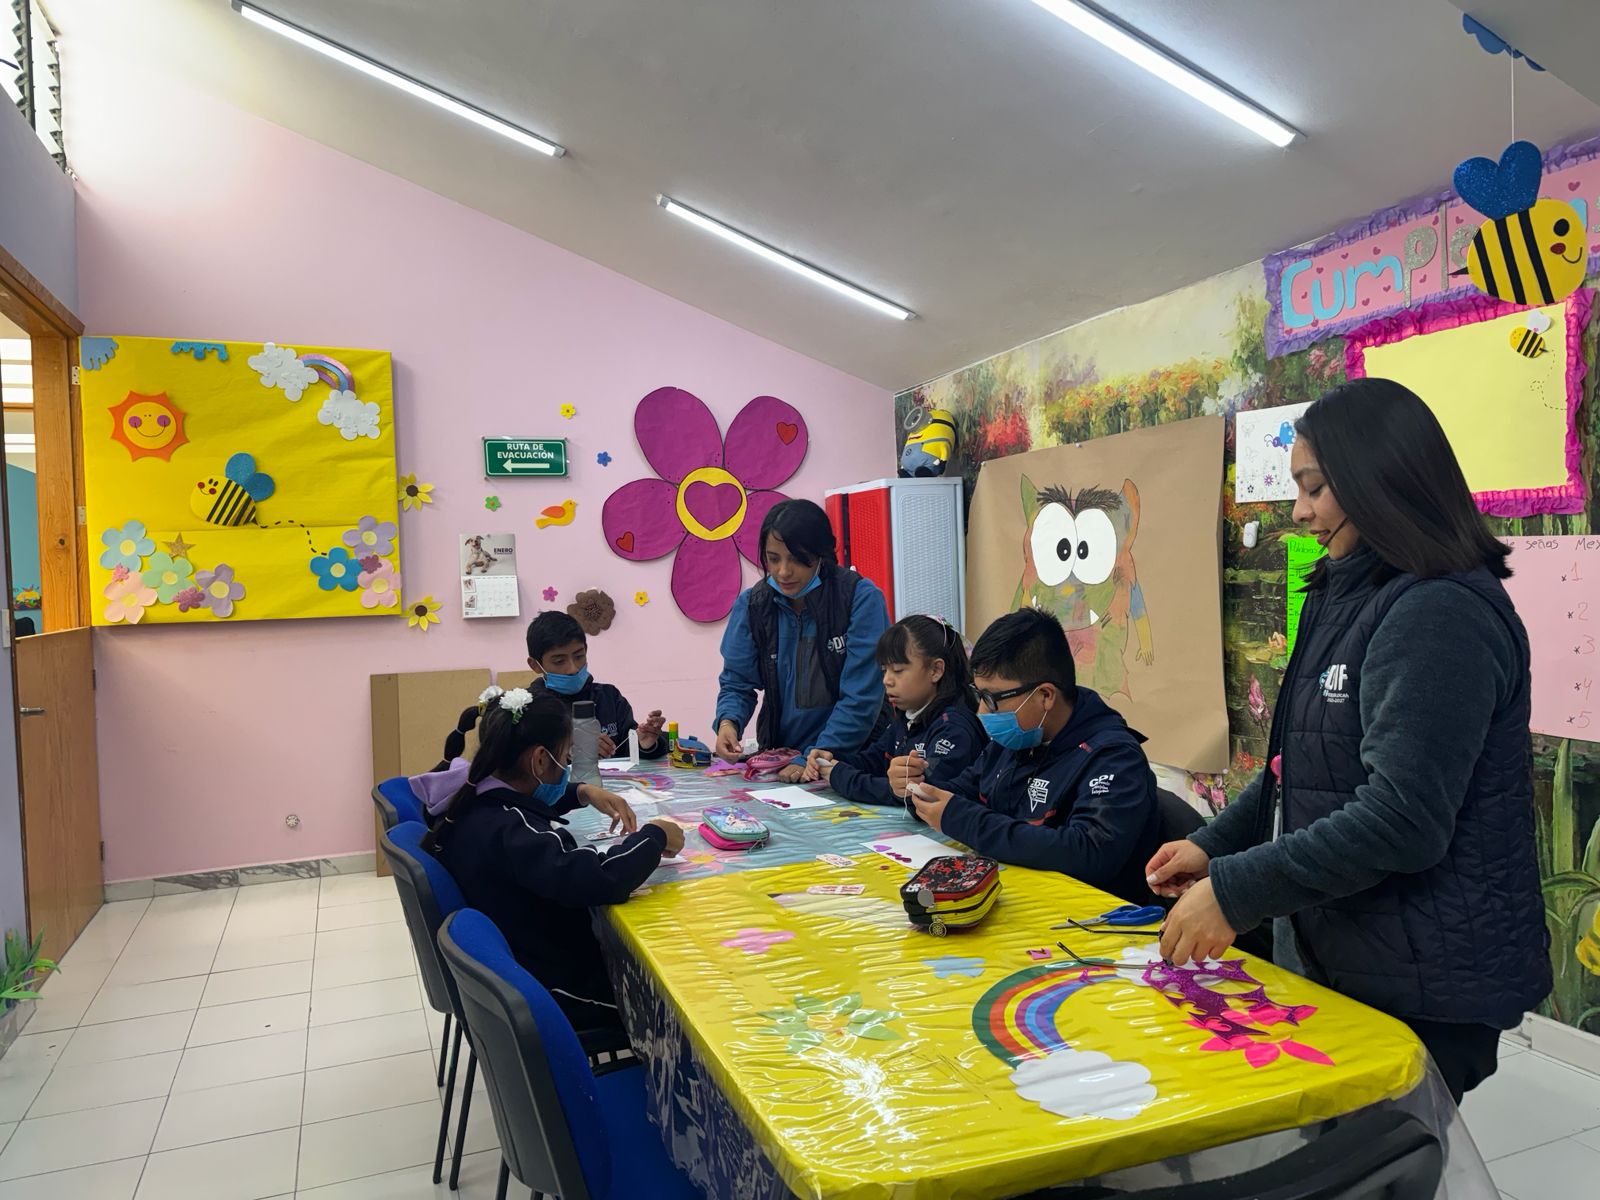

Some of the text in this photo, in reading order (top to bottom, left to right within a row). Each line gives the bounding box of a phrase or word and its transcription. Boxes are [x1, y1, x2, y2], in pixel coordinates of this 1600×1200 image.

[507, 443, 544, 451] RUTA DE
[497, 450, 554, 459] EVACUACIÓN
[1525, 539, 1559, 550] señas
